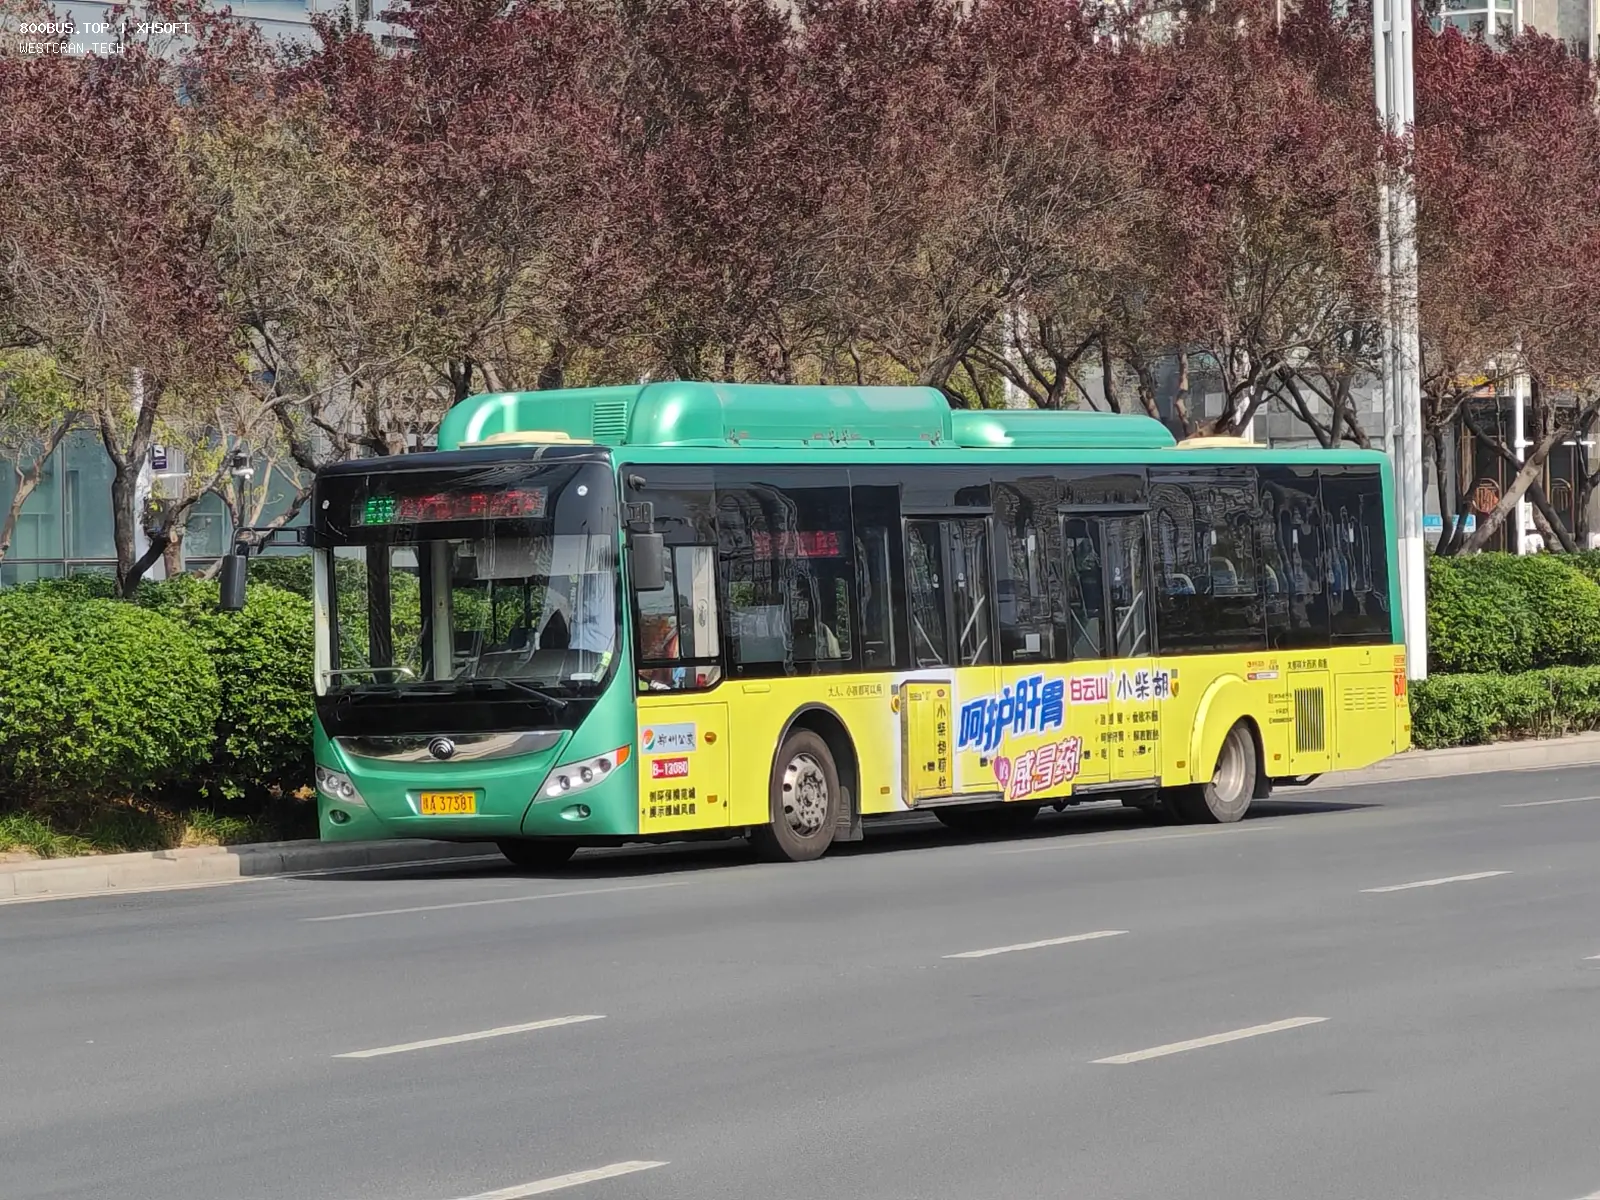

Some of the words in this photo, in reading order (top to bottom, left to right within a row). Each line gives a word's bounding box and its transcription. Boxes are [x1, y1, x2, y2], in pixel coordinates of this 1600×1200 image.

[1069, 677, 1109, 701] 白云山
[1116, 670, 1169, 700] 小柴胡
[957, 674, 1065, 751] 呵护肝胃
[1010, 736, 1083, 798] 感冒药
